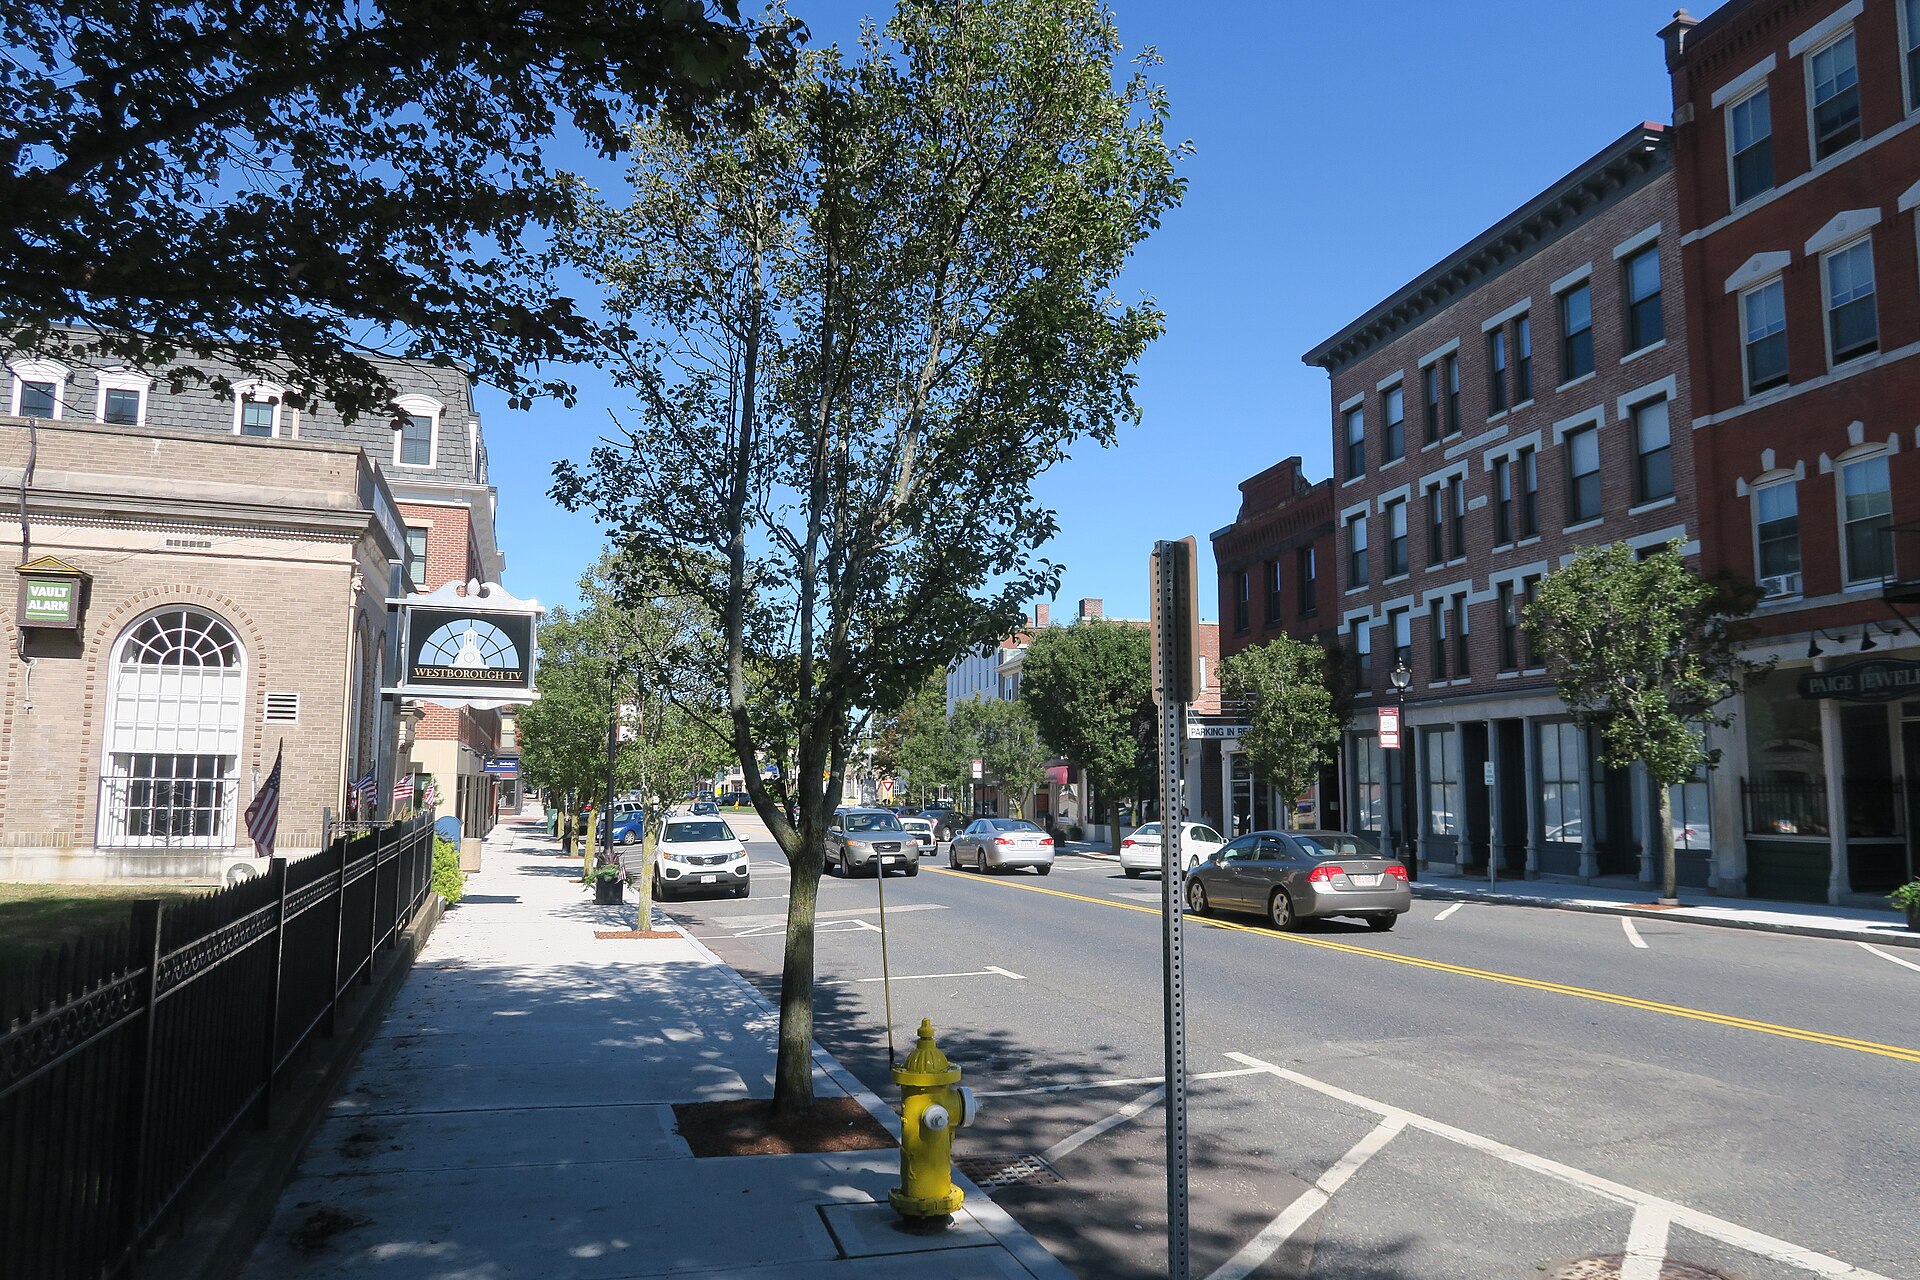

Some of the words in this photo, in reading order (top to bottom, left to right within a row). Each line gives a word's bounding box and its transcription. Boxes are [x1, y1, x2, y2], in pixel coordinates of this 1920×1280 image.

[29, 586, 68, 597] VAULT
[28, 600, 68, 611] ALARM
[414, 667, 504, 679] WESTBOROUGH
[506, 671, 522, 680] TV
[1809, 675, 1854, 693] PAIGE
[1191, 727, 1224, 736] PARKING
[1227, 727, 1235, 736] IN
